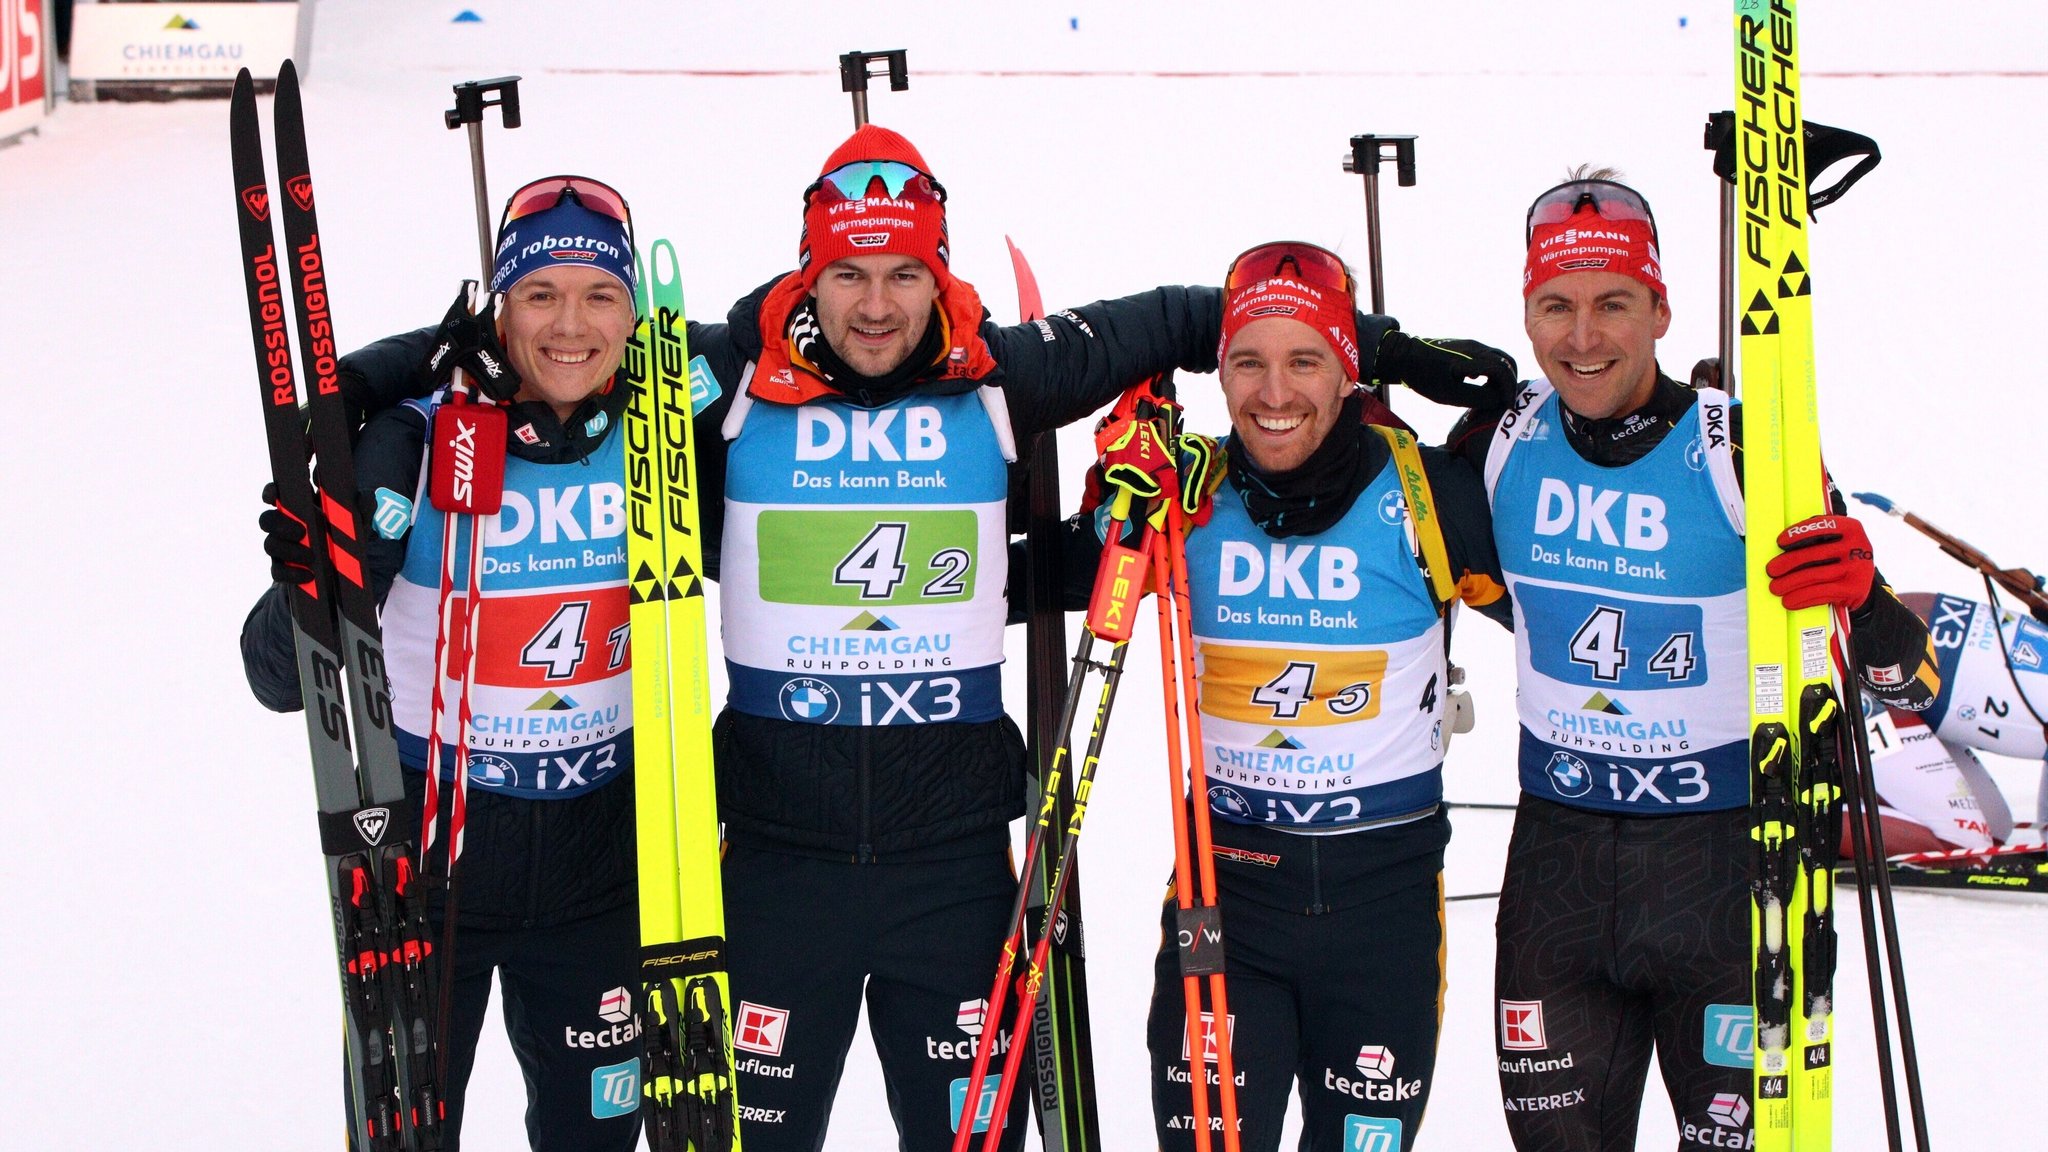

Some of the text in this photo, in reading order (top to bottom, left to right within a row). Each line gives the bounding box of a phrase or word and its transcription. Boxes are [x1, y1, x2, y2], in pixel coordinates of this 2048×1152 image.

[122, 44, 243, 60] CHIEMGAU
[1741, 14, 1771, 269] FISCHER
[831, 217, 914, 234] Wärmepumpen
[1539, 229, 1630, 250] VIESSMANN
[521, 235, 619, 259] robotron
[1540, 246, 1629, 264] Wärmepumpen
[298, 234, 340, 395] ROSSIGNOL
[1232, 293, 1319, 316] Wärmepumpen
[254, 244, 294, 405] ROSSIGNOL
[625, 314, 654, 541] FISCHER
[658, 306, 692, 536] FISCHER
[1498, 388, 1539, 440] JOKA
[1612, 415, 1658, 441] tectake
[1704, 403, 1726, 450] JOKA
[795, 405, 947, 462] DKB
[1139, 422, 1151, 460] LEKI
[792, 470, 947, 488] Das kann Bank
[483, 481, 627, 548] DKB
[1534, 477, 1669, 551] DKB
[482, 547, 626, 575] Das kann Bank
[833, 521, 971, 600] 4 2
[1218, 541, 1361, 602] DKB
[1531, 543, 1667, 580] Das kann Bank
[1104, 554, 1135, 631] LEKI
[1217, 605, 1358, 629] Das kann Bank
[1932, 596, 1972, 649] iX3
[520, 600, 591, 682] 4
[787, 633, 952, 656] CHIEMGAU
[1568, 603, 1697, 683] 4 4
[787, 656, 952, 670] RUHPOLDING
[786, 679, 832, 695] BMW
[861, 676, 963, 726] iX3
[1249, 660, 1319, 720] 4
[1418, 672, 1439, 714] 4
[469, 725, 617, 749] RUHPOLDING
[471, 704, 620, 735] CHIEMGAU
[1547, 708, 1688, 740] CHIEMGAU
[1551, 730, 1691, 754] RUHPOLDING
[1214, 745, 1355, 775] CHIEMGAU
[1215, 764, 1353, 789] RUHPOLDING
[1039, 747, 1068, 827] LEKI
[1067, 755, 1098, 836] LEKI
[1607, 761, 1711, 804] iX3
[1967, 875, 2029, 886] FISCHER
[642, 949, 719, 968] FISCHER
[1033, 994, 1058, 1112] ROSSIGNOL
[1809, 1047, 1826, 1065] 4/4
[1324, 1067, 1422, 1101] tectake
[1517, 1087, 1586, 1112] TERREX
[1765, 1079, 1782, 1095] 4/4
